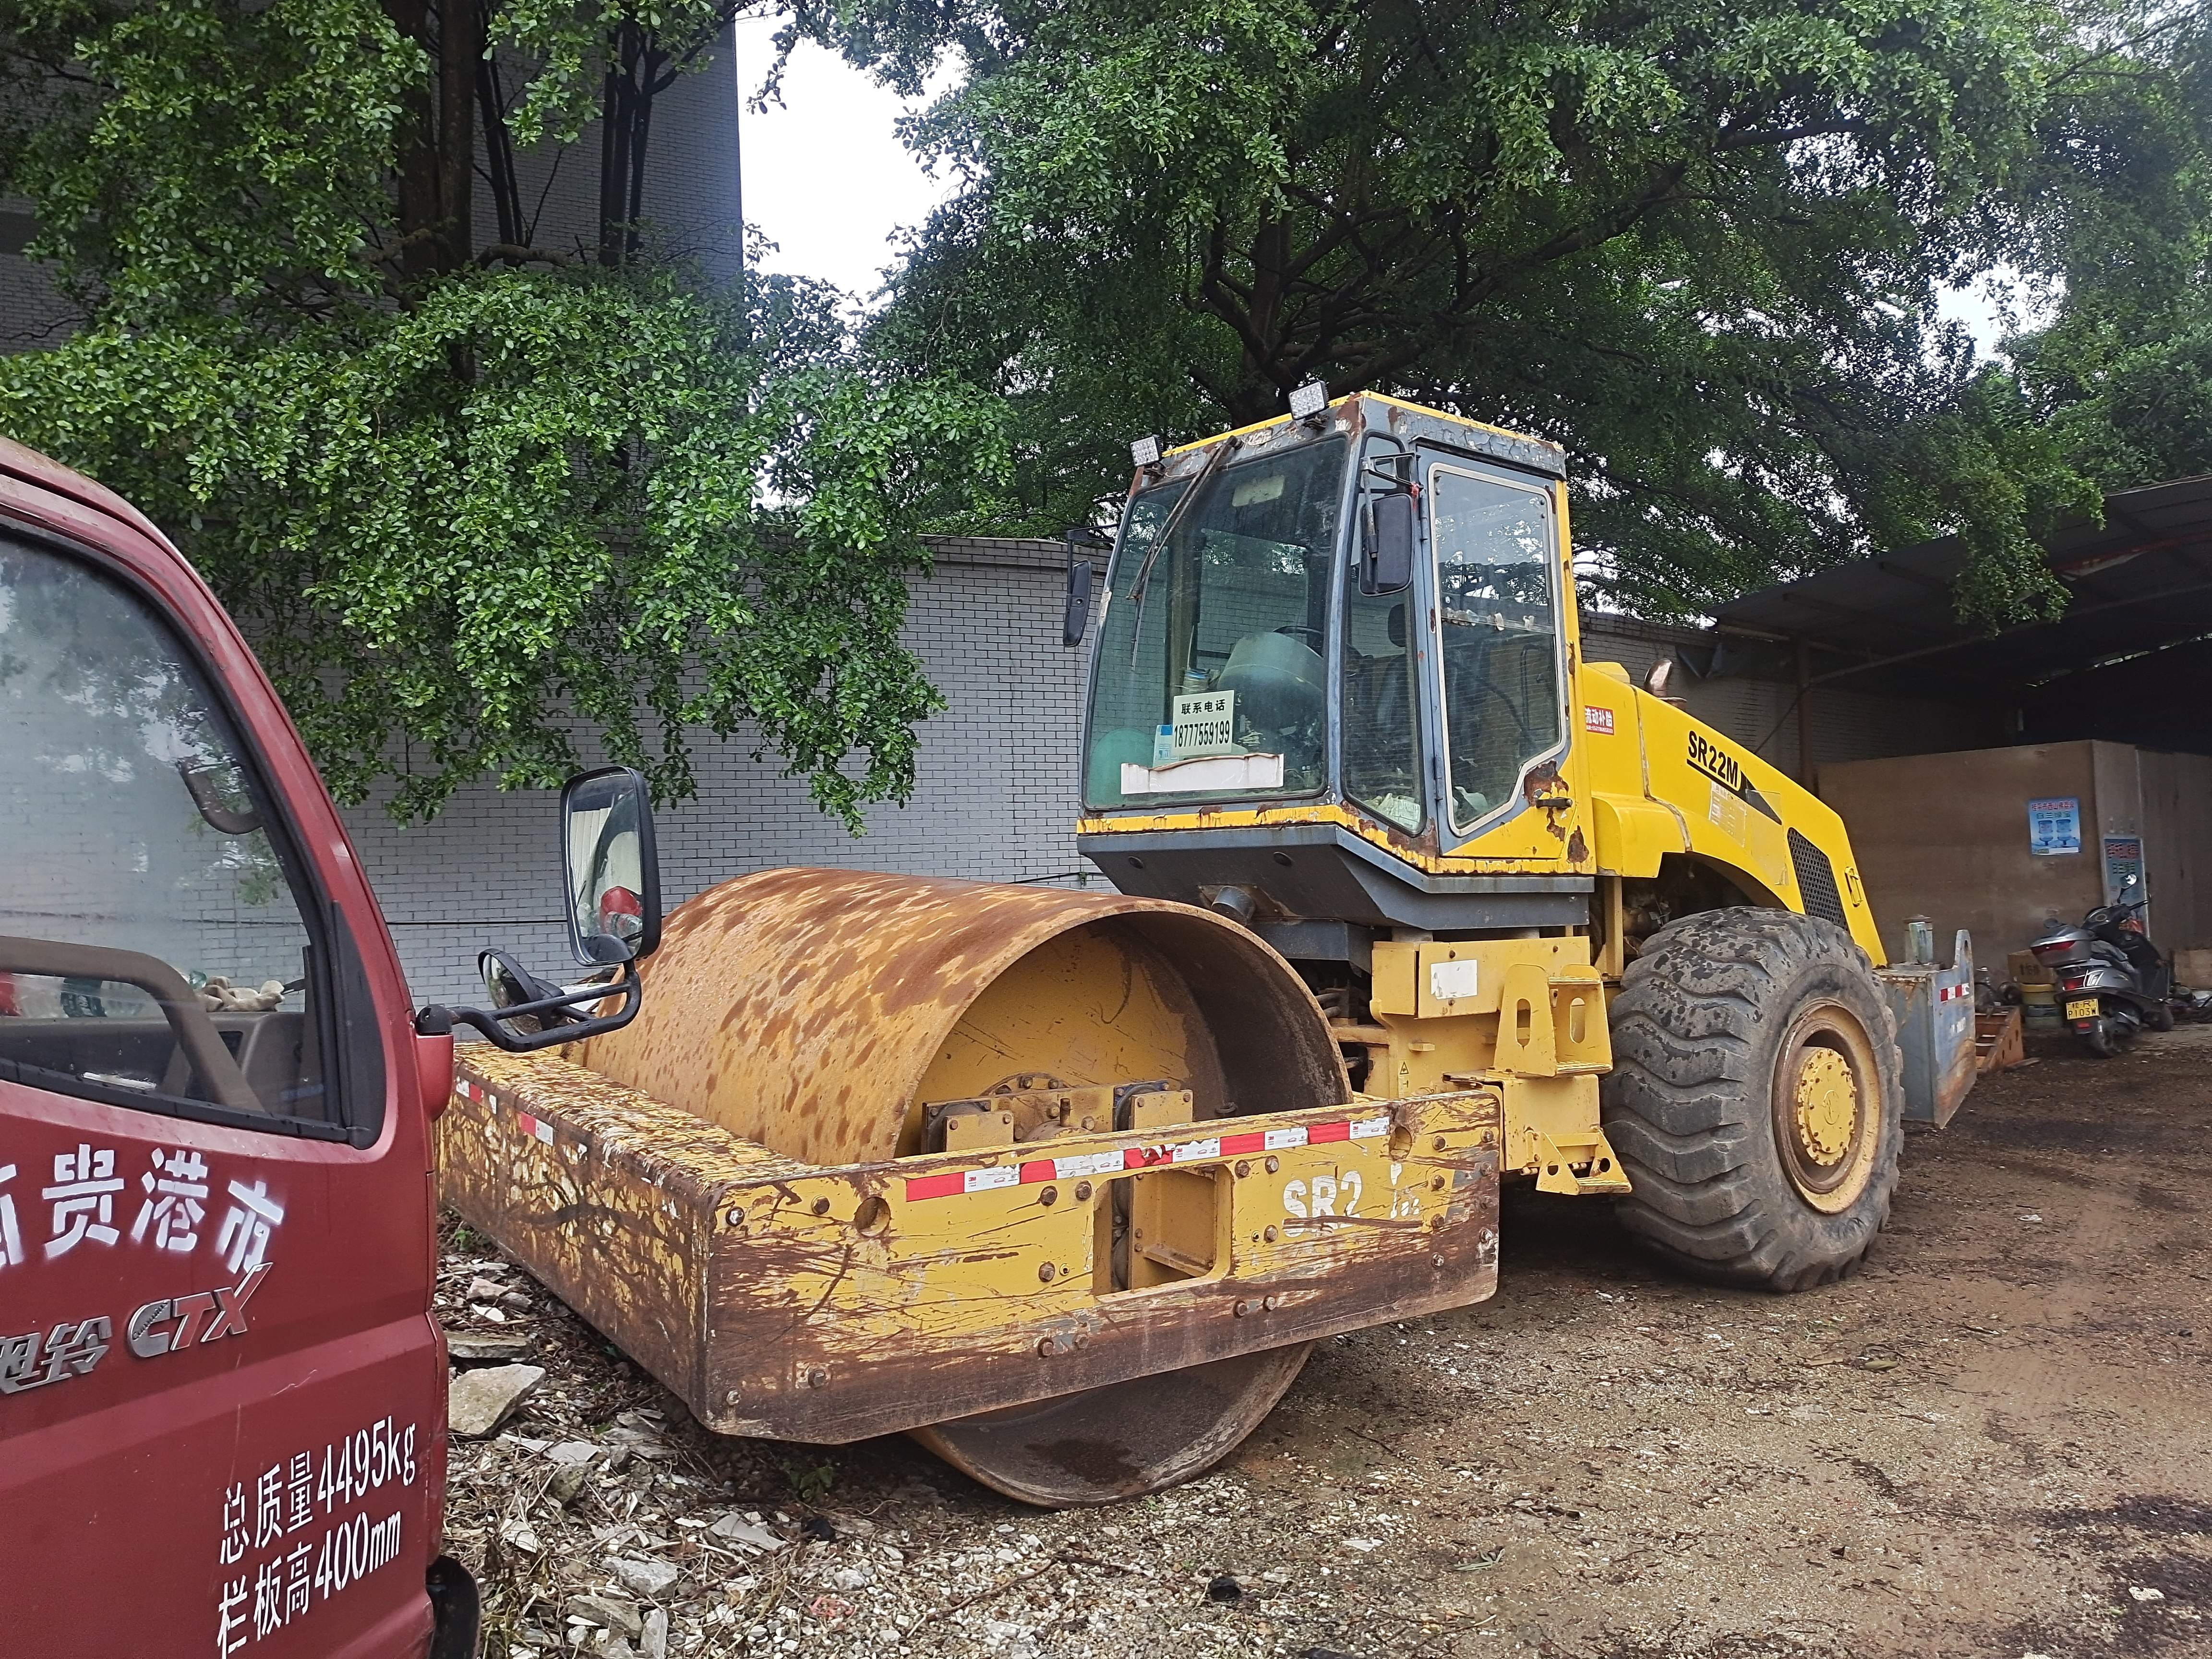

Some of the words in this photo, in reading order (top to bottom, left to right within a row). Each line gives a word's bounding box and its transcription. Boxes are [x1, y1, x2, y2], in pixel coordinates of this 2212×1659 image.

[1181, 699, 1226, 715] 联系电话
[1585, 708, 1613, 727] 流动补胎
[1174, 720, 1230, 748] 18777559199
[1688, 730, 1738, 788] SR22M
[128, 1262, 273, 1358] CTX
